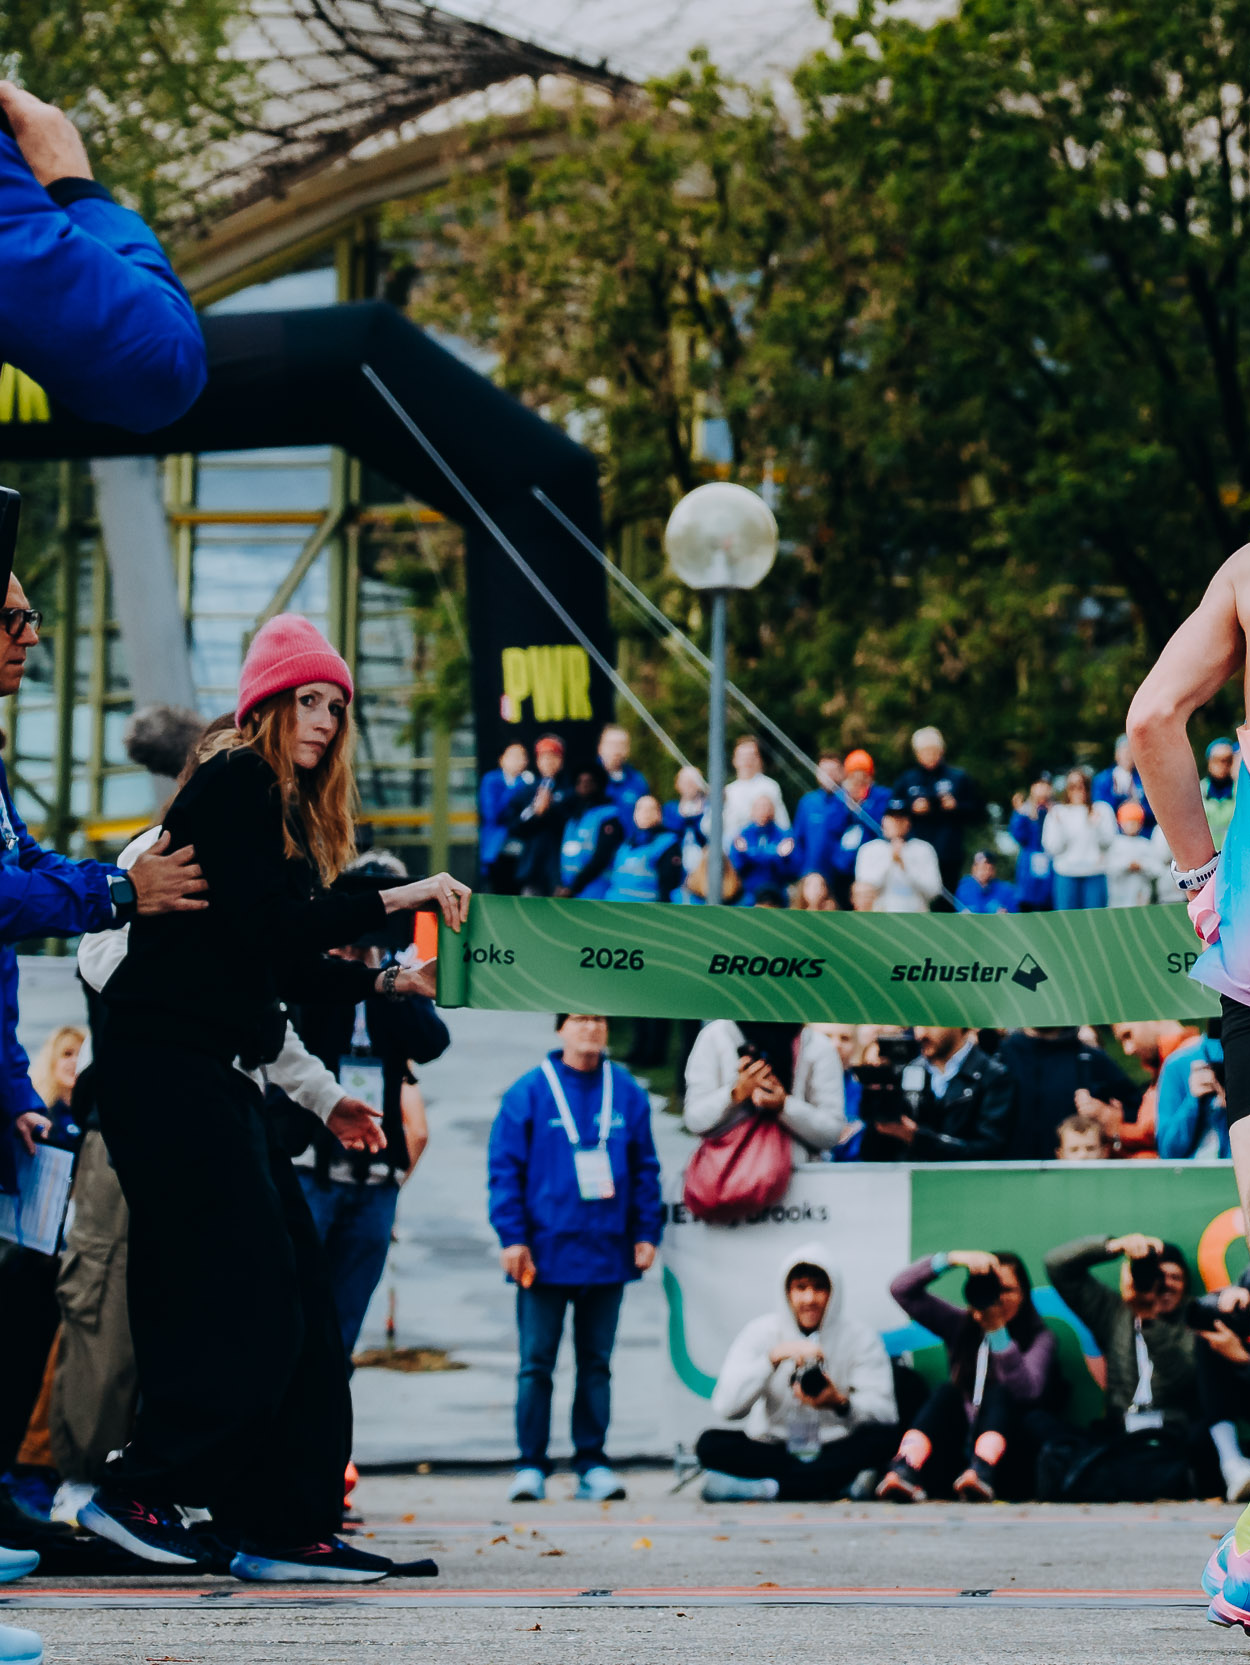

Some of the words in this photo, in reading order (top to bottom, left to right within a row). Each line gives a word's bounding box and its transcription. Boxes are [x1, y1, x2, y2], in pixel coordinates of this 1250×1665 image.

[580, 946, 645, 971] 2026
[707, 954, 826, 978] BROOKS
[890, 957, 1008, 983] schuster
